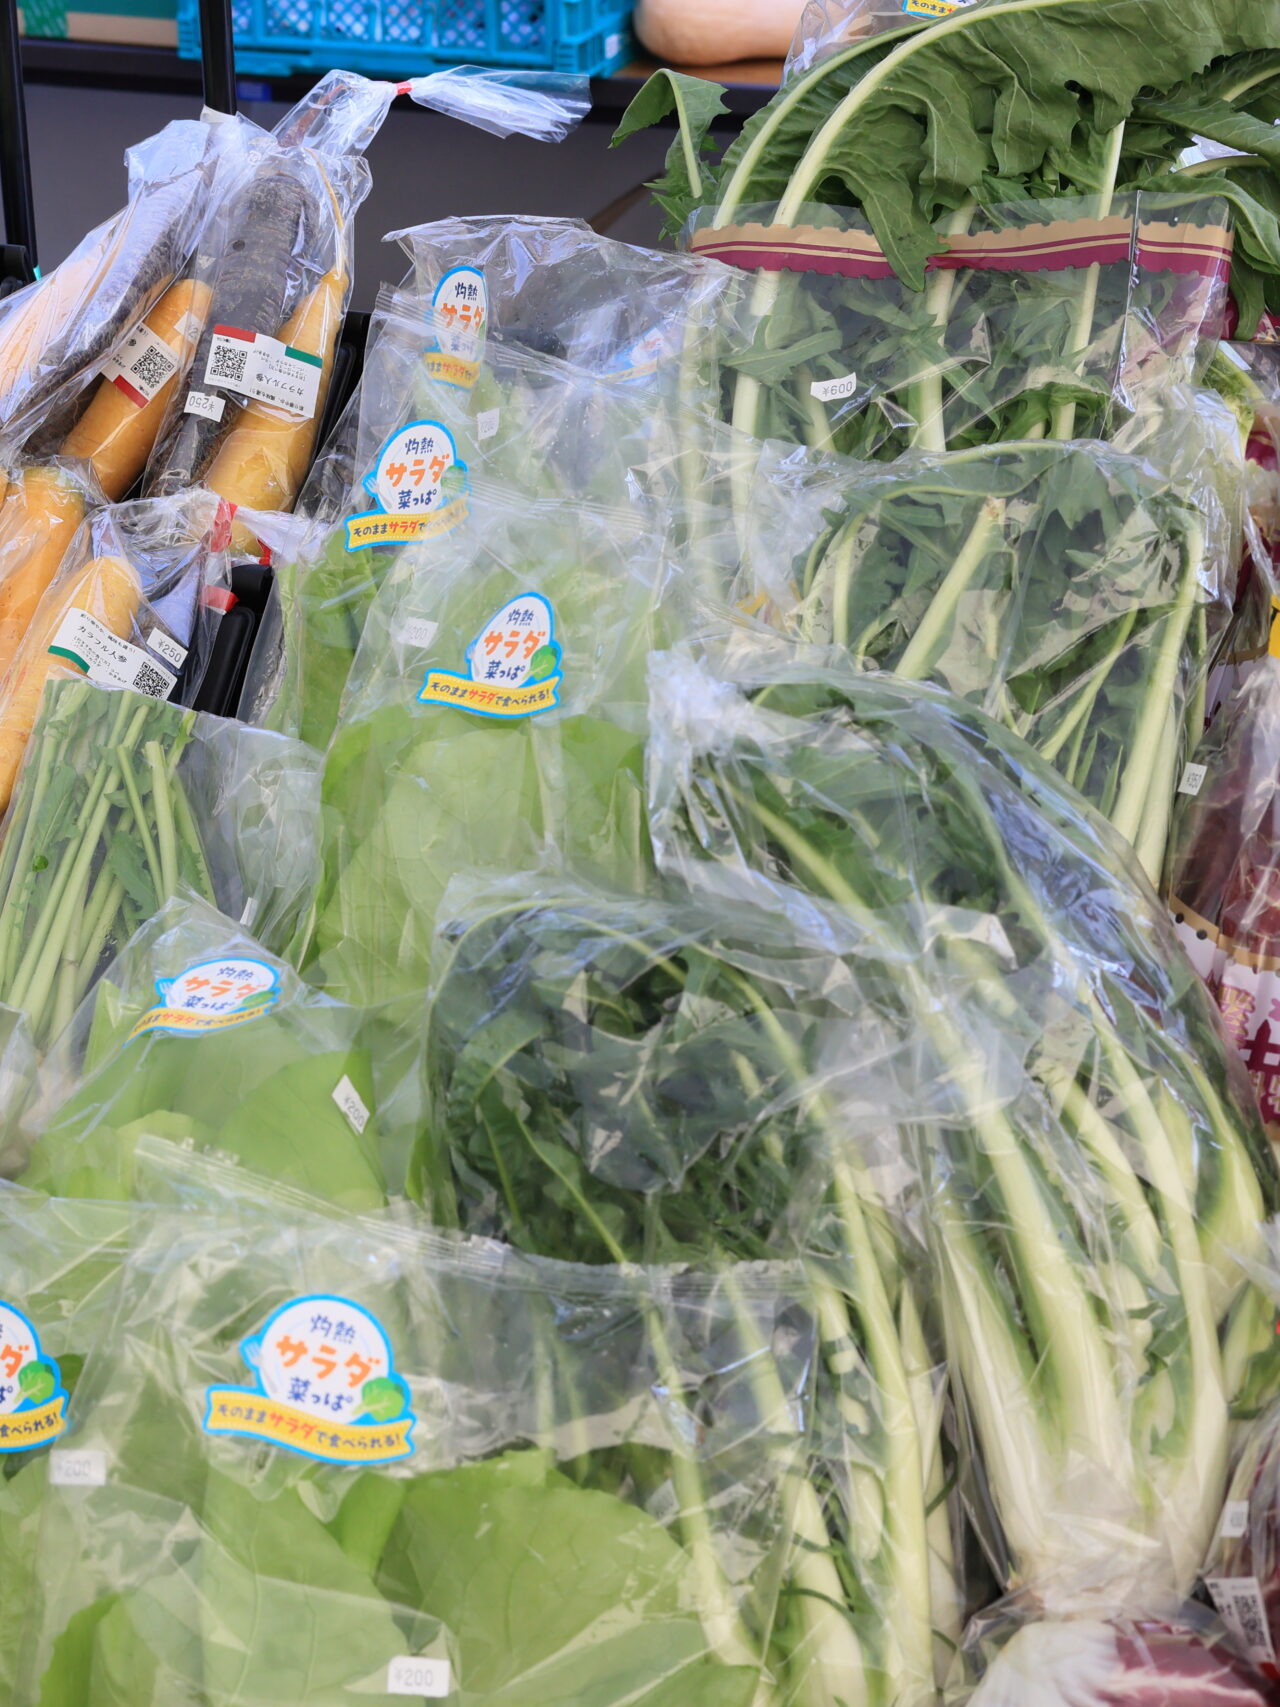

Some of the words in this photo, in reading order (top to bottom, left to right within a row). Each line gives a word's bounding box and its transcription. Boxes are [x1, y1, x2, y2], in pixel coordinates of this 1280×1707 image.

[256, 373, 305, 396] カラフル人参
[822, 381, 853, 396] ¥600
[189, 395, 215, 412] ¥250
[405, 437, 434, 455] 灼熱
[385, 454, 450, 487] サラダ
[398, 488, 437, 509] 菜っぱ
[507, 608, 535, 626] 灼熱
[78, 625, 128, 663] カラフル人参
[157, 639, 182, 663] ¥250
[484, 630, 546, 659] サラダ
[485, 660, 526, 680] 菜っぱ
[431, 682, 550, 707] そのままサラダで食べられる!
[218, 966, 255, 981] 灼熱
[184, 976, 267, 1000] サラダ
[181, 995, 236, 1011] 菜っぱ
[343, 1096, 365, 1128] ¥200
[311, 1314, 356, 1344] 灼熱
[276, 1335, 381, 1388] サラダ
[288, 1376, 354, 1411] 菜っぱ
[218, 1404, 402, 1449] そのままサラダで食べられる!
[394, 1667, 434, 1687] ¥200
